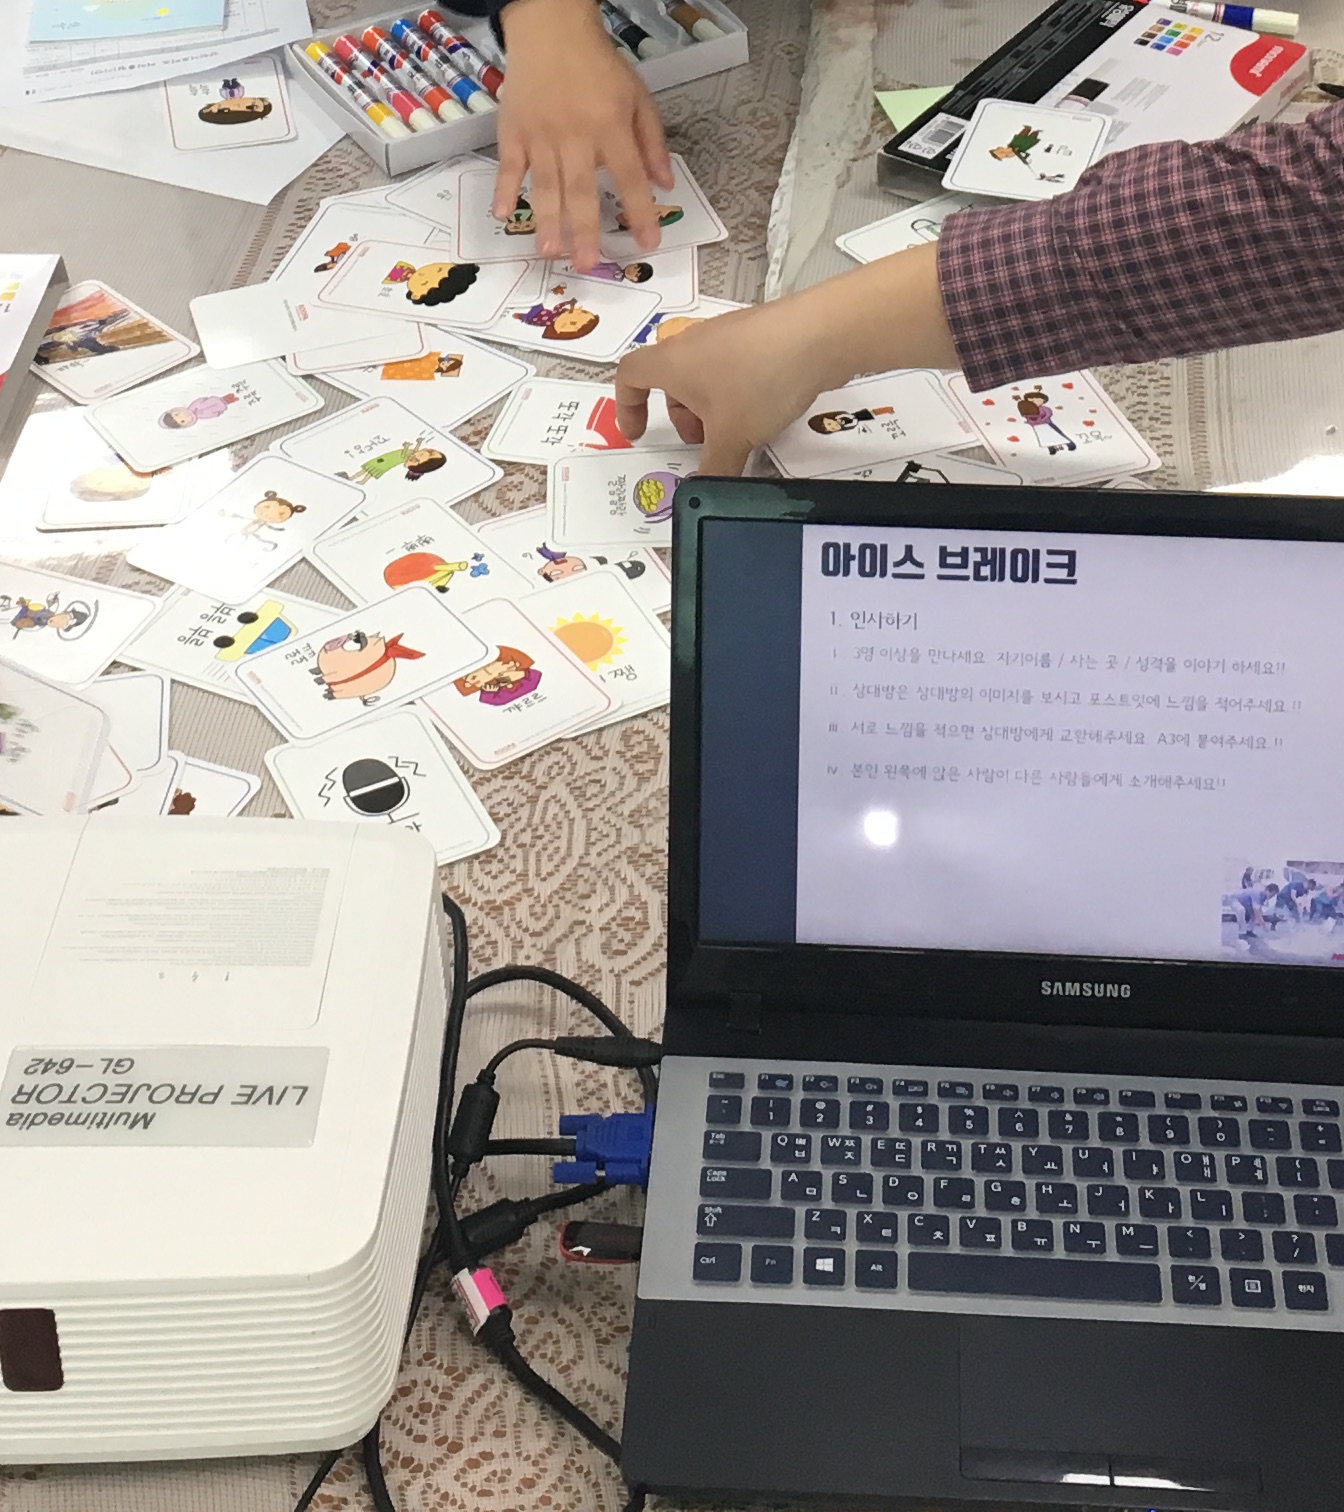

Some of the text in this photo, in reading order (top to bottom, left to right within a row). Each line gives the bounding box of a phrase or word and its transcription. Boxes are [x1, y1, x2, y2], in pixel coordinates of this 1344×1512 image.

[821, 541, 1078, 585] 아이스 브레이크
[850, 610, 918, 631] 인사하기
[928, 648, 985, 665] 만나세요
[1070, 654, 1099, 671] 사는
[1183, 658, 1226, 674] 이야기
[1041, 689, 1082, 706] 보시고
[1041, 980, 1133, 1000] SAMSUNG
[23, 1056, 135, 1077] GL-642
[10, 1082, 309, 1107] LIVE PROJECTOR
[5, 1109, 158, 1131] Multimedia
[768, 1111, 774, 1121] 1
[815, 1113, 824, 1123] 2
[865, 1114, 874, 1125] 3
[914, 1117, 924, 1127] 4
[965, 1120, 974, 1130] 5
[1015, 1122, 1024, 1132] 6
[1065, 1124, 1074, 1134] 7
[777, 1134, 789, 1146] Q
[827, 1136, 842, 1148] W
[876, 1139, 886, 1150] E
[927, 1141, 937, 1152] R
[978, 1144, 988, 1155] T
[1028, 1146, 1039, 1157] Y
[1078, 1149, 1089, 1160] U
[1131, 1152, 1137, 1162] I
[1180, 1153, 1193, 1165] O
[1231, 1156, 1241, 1167] P
[788, 1172, 799, 1183] A
[838, 1174, 848, 1185] S
[888, 1176, 900, 1187] D
[940, 1179, 949, 1190] F
[990, 1181, 1002, 1193] G
[1042, 1184, 1053, 1195] H
[1094, 1186, 1104, 1197] J
[1144, 1189, 1155, 1200] K
[1196, 1191, 1206, 1202] L
[811, 1210, 821, 1222] Z
[862, 1214, 873, 1224] X
[914, 1215, 924, 1226] C
[965, 1218, 977, 1229] V
[1017, 1221, 1027, 1232] B
[1069, 1223, 1081, 1234] N
[1122, 1226, 1134, 1236] M
[699, 1255, 716, 1265] Ctrl
[870, 1263, 883, 1272] Alt
